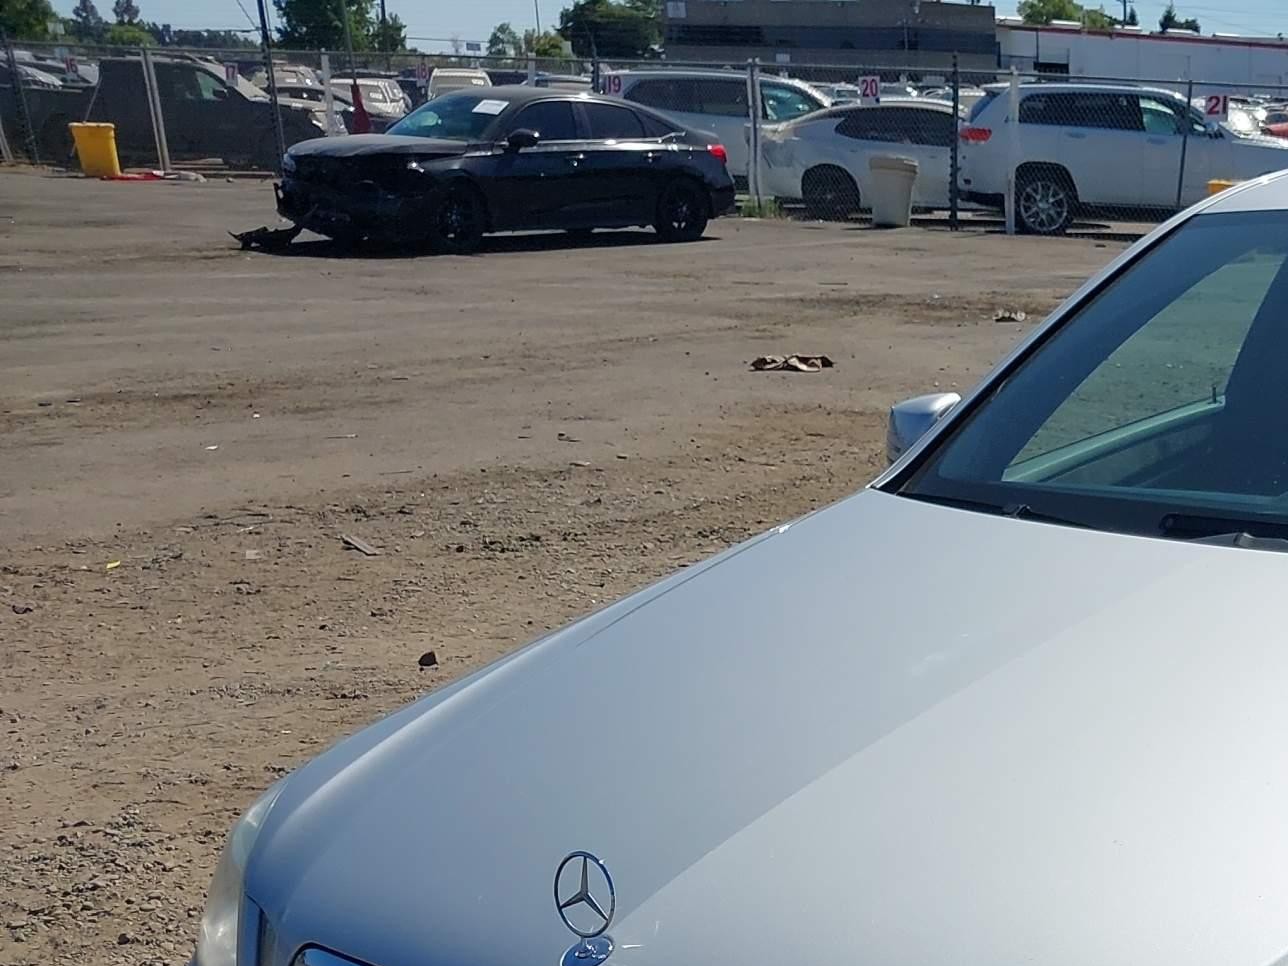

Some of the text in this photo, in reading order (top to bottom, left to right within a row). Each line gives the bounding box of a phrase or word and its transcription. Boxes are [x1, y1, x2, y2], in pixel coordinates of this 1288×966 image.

[607, 75, 622, 94] 19
[861, 79, 878, 97] 20
[1206, 95, 1227, 115] 21
